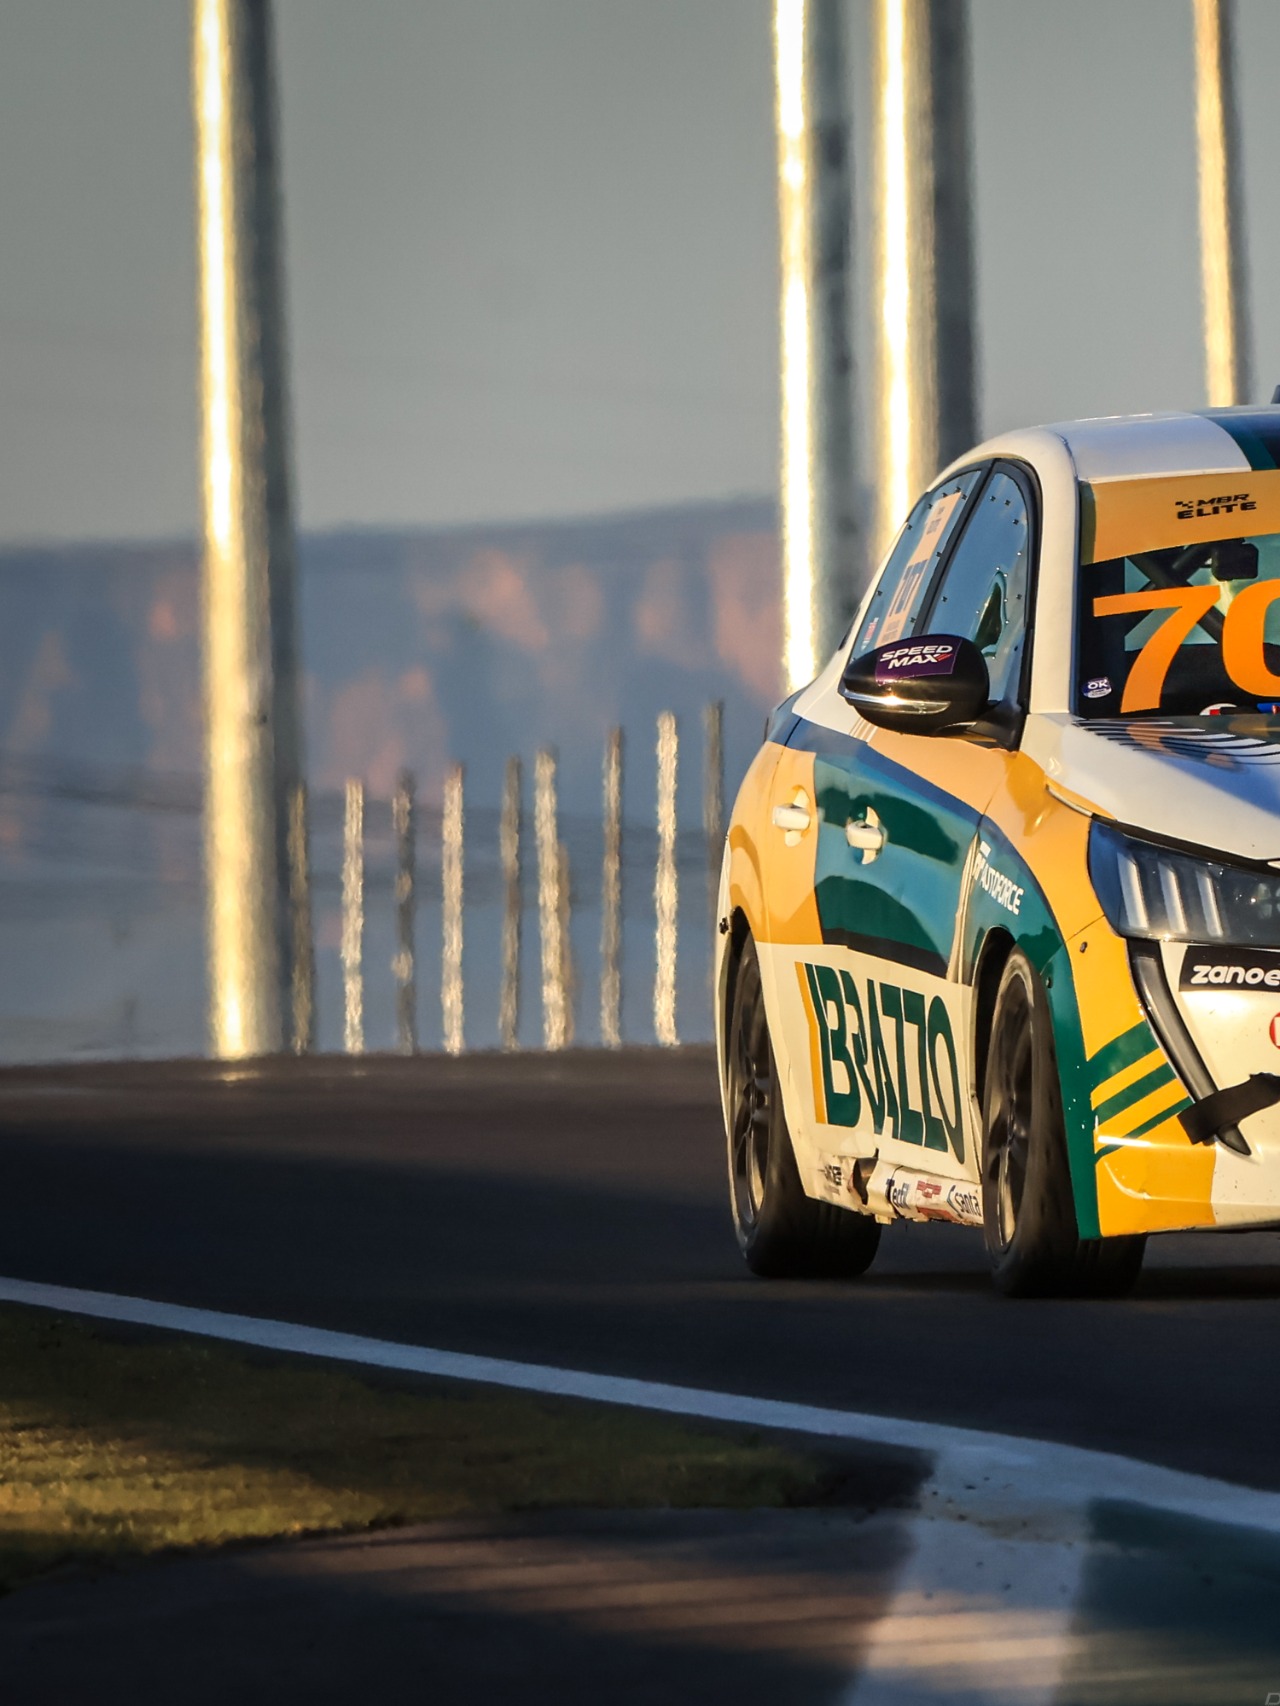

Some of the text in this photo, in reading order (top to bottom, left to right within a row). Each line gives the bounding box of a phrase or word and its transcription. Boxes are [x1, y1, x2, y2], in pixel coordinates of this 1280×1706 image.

[1196, 493, 1250, 507] MBR
[1176, 501, 1257, 520] ELITE
[879, 645, 953, 663] SPEED
[887, 654, 938, 670] MAX
[804, 962, 965, 1165] BRAZZO
